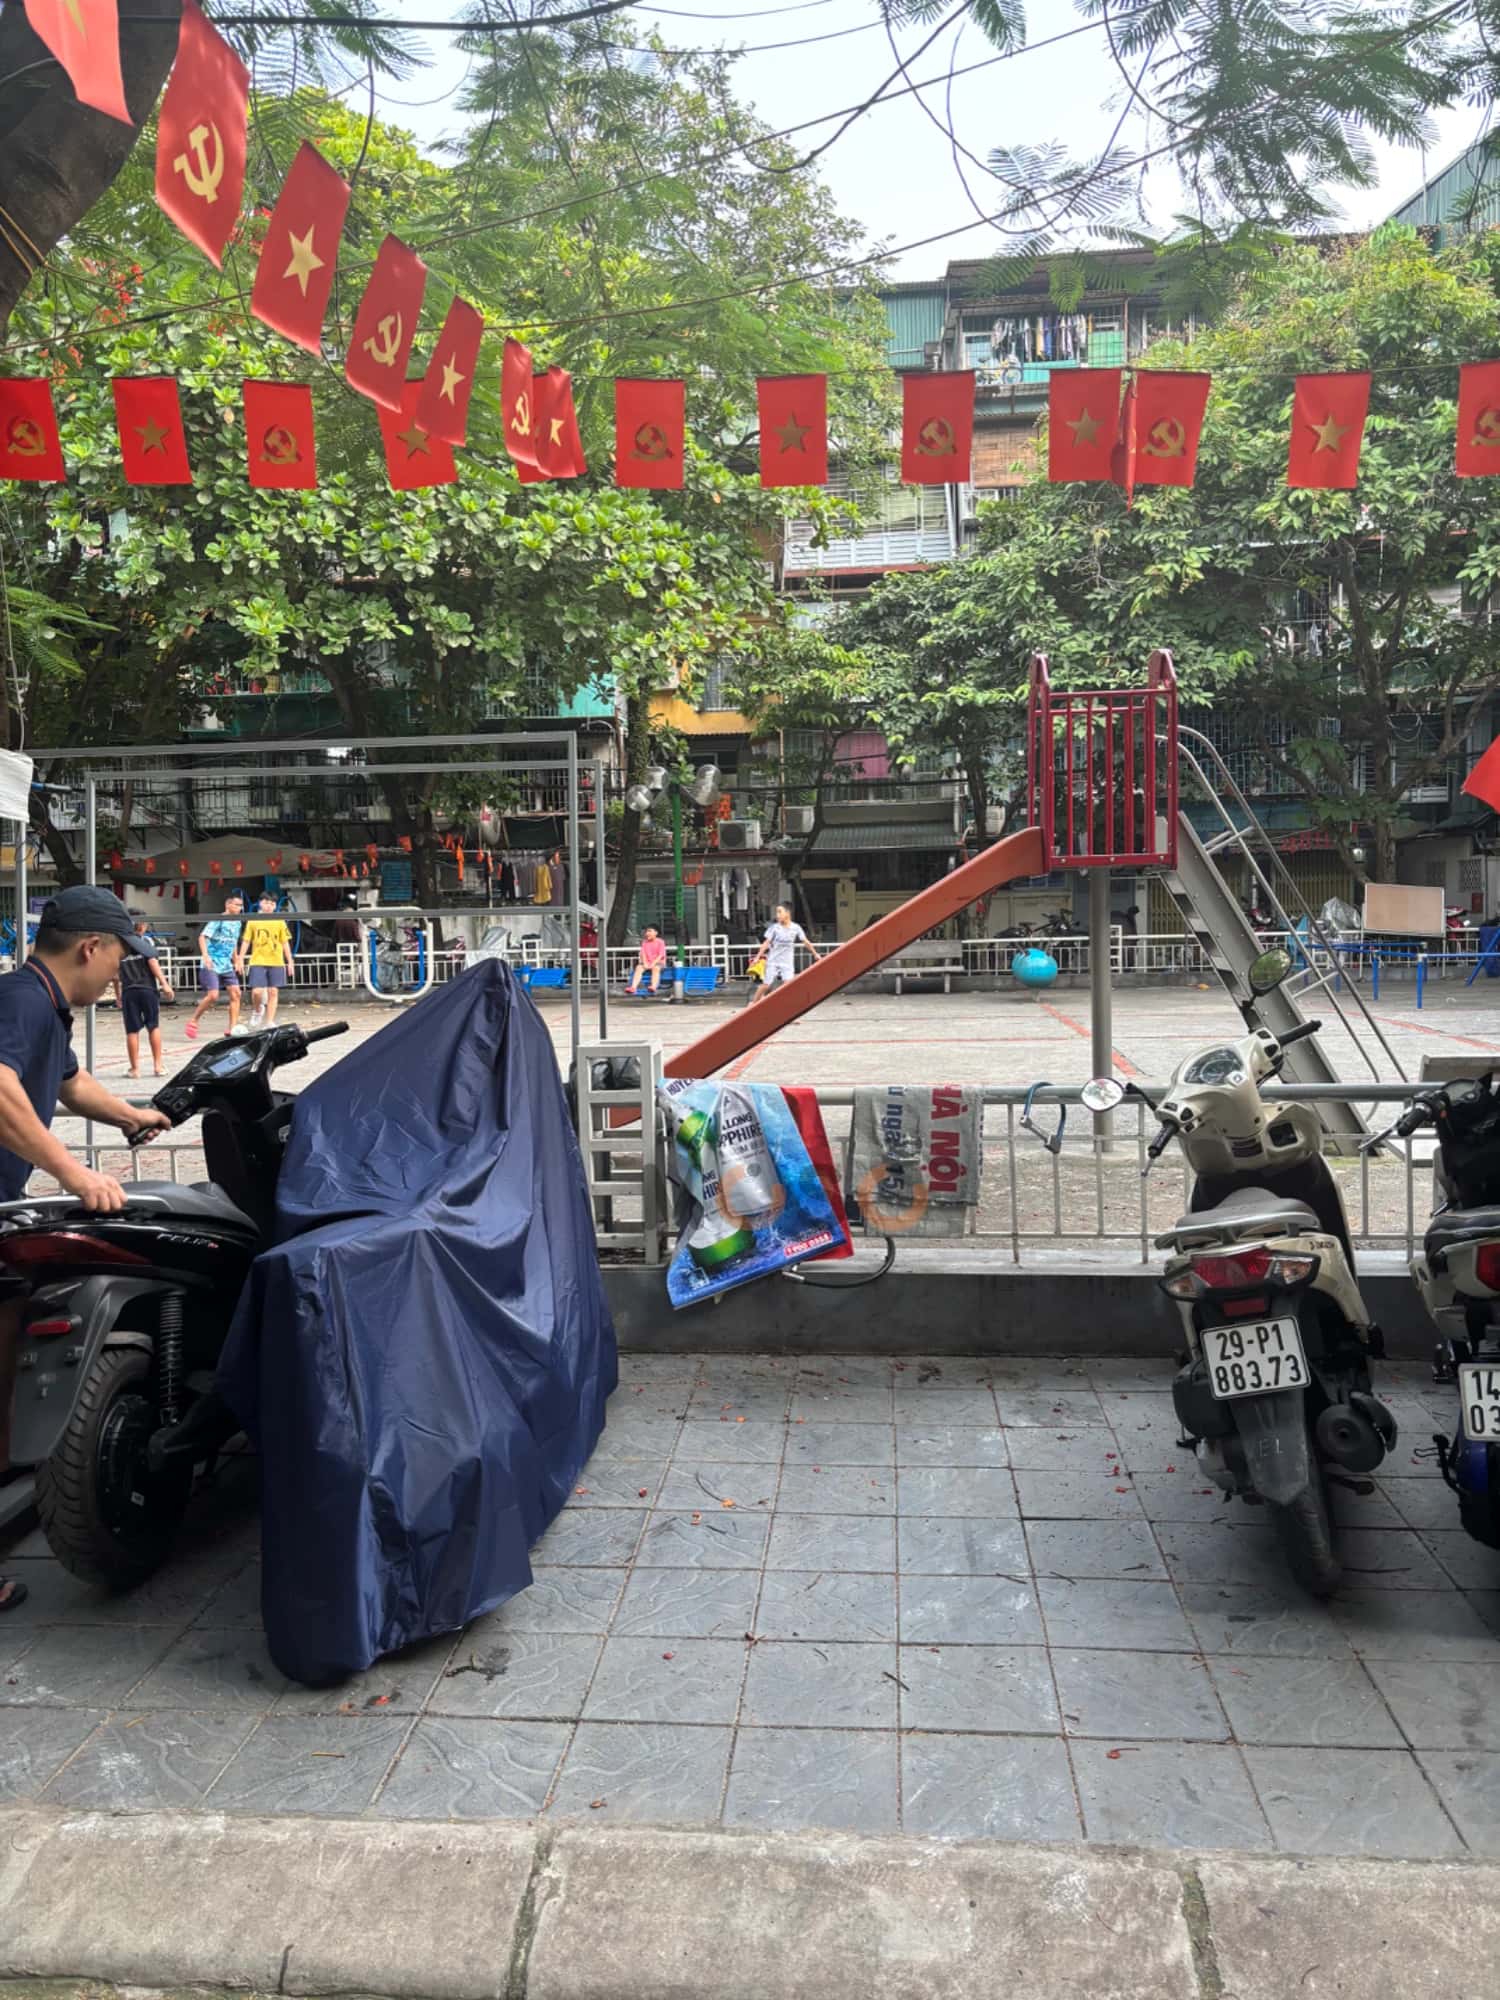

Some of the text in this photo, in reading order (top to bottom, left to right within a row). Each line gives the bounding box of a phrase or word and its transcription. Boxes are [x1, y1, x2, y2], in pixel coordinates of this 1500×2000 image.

[921, 1131, 968, 1192] NỘI
[1215, 1323, 1284, 1361] 29-P1
[1215, 1354, 1301, 1393] 883.73
[1472, 1369, 1500, 1400] 14
